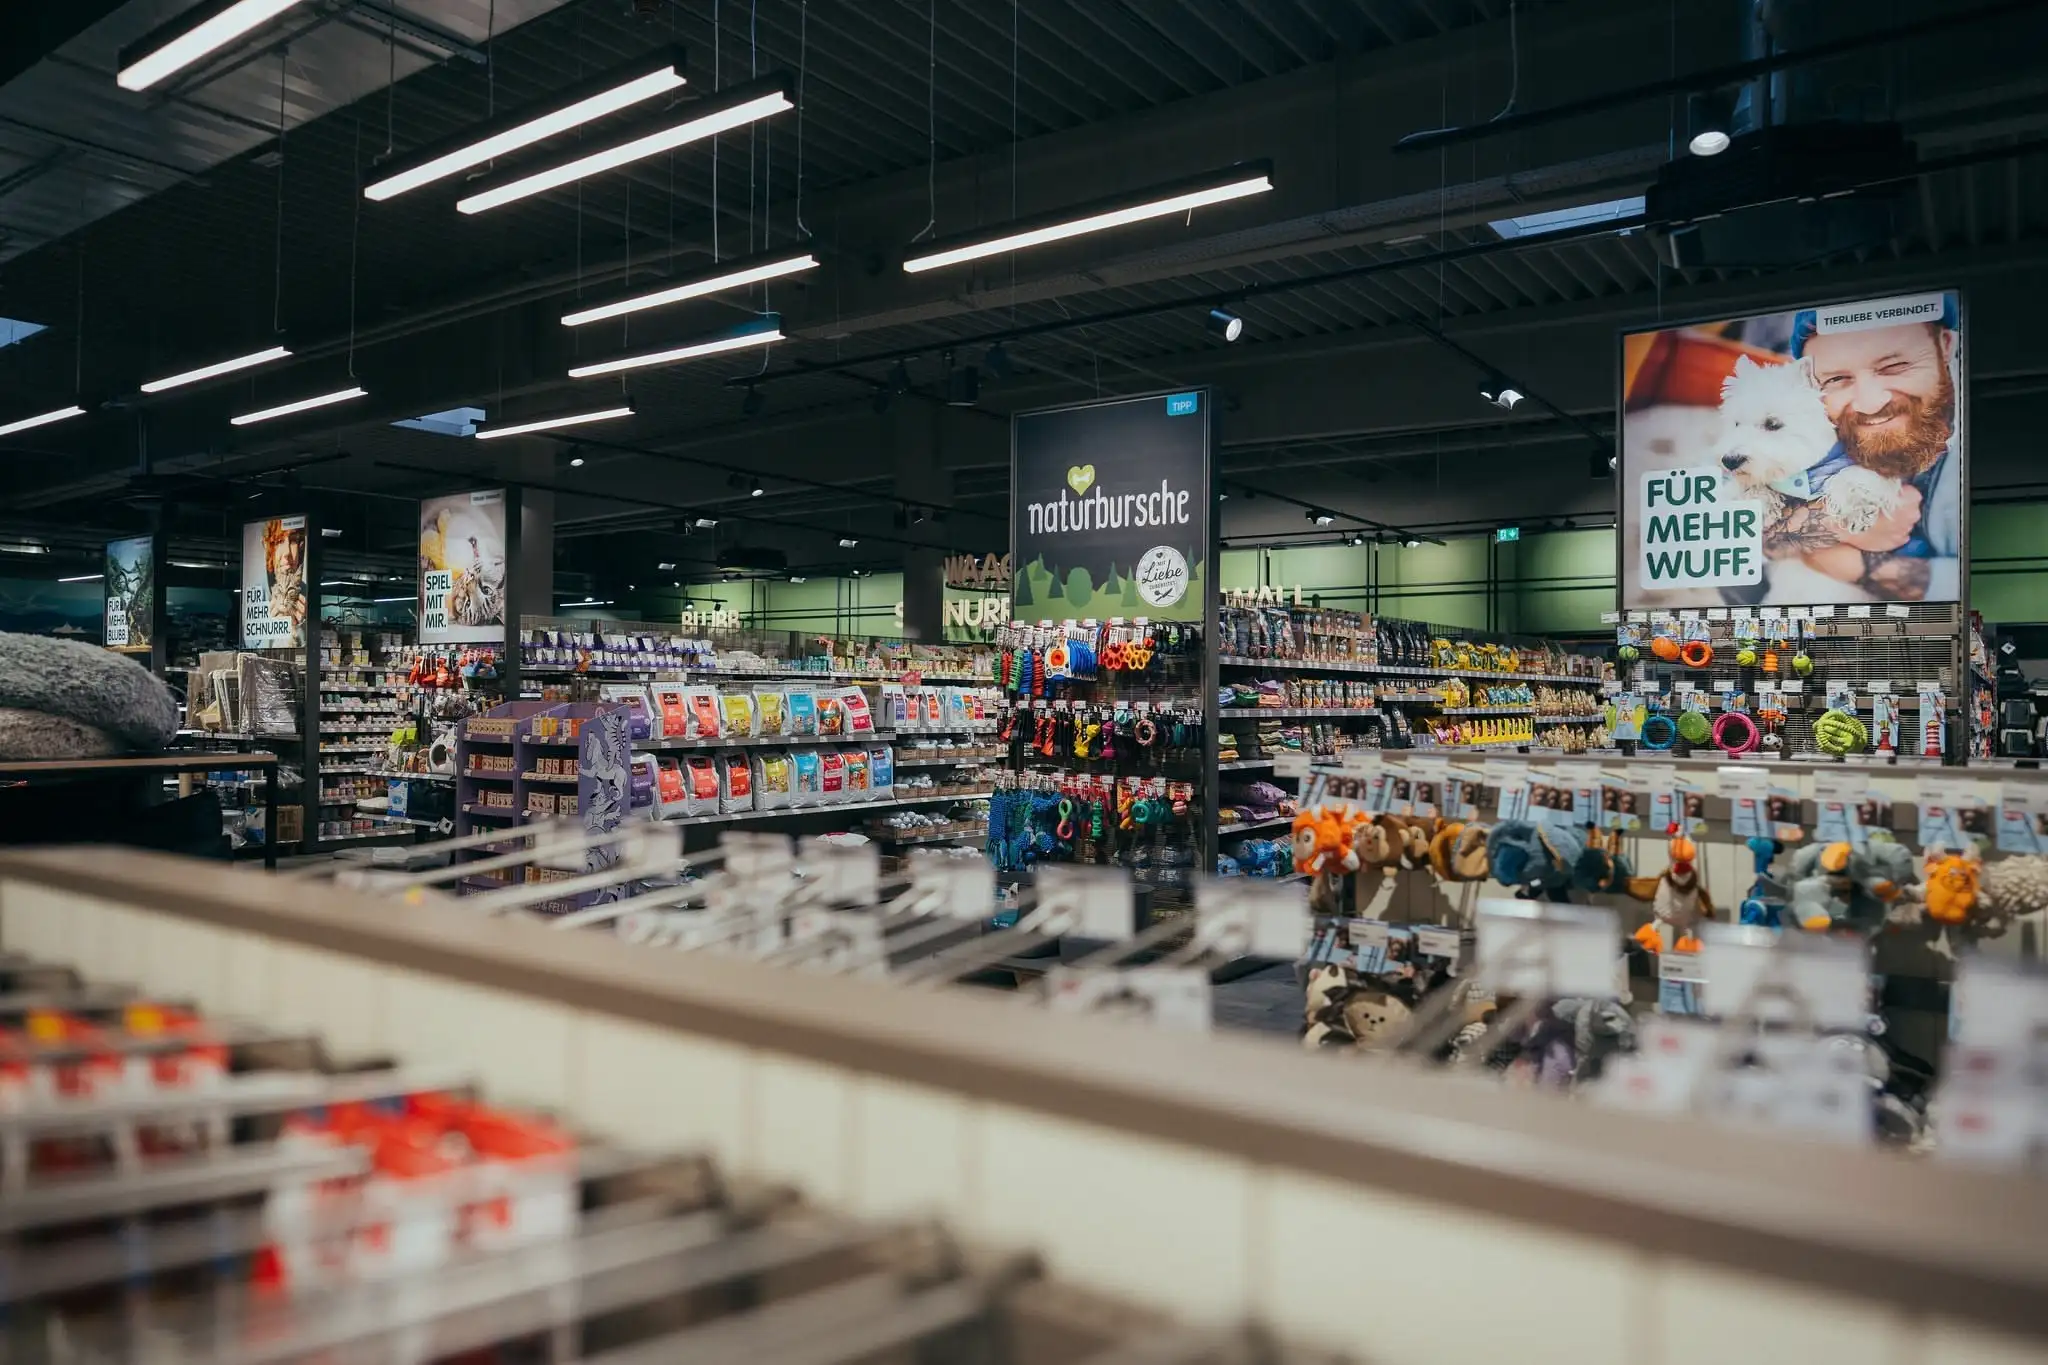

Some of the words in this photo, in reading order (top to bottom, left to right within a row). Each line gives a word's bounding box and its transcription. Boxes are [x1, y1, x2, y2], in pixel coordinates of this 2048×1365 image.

[1824, 311, 1873, 326] TIERLIEBE
[1875, 303, 1939, 319] VERBINDET.
[1172, 400, 1192, 412] TIPP
[1647, 470, 1717, 508] FÜR
[1027, 478, 1190, 535] naturbursche
[1646, 509, 1757, 544] MEHR
[1141, 559, 1183, 584] Liebe
[1646, 546, 1756, 580] WUFF.
[425, 574, 451, 591] SPIEL
[246, 587, 262, 603] FÜR
[425, 594, 444, 609] MIT
[246, 605, 269, 620] MEHR
[425, 613, 447, 629] MIR.
[246, 620, 291, 636] SCHNURRR.
